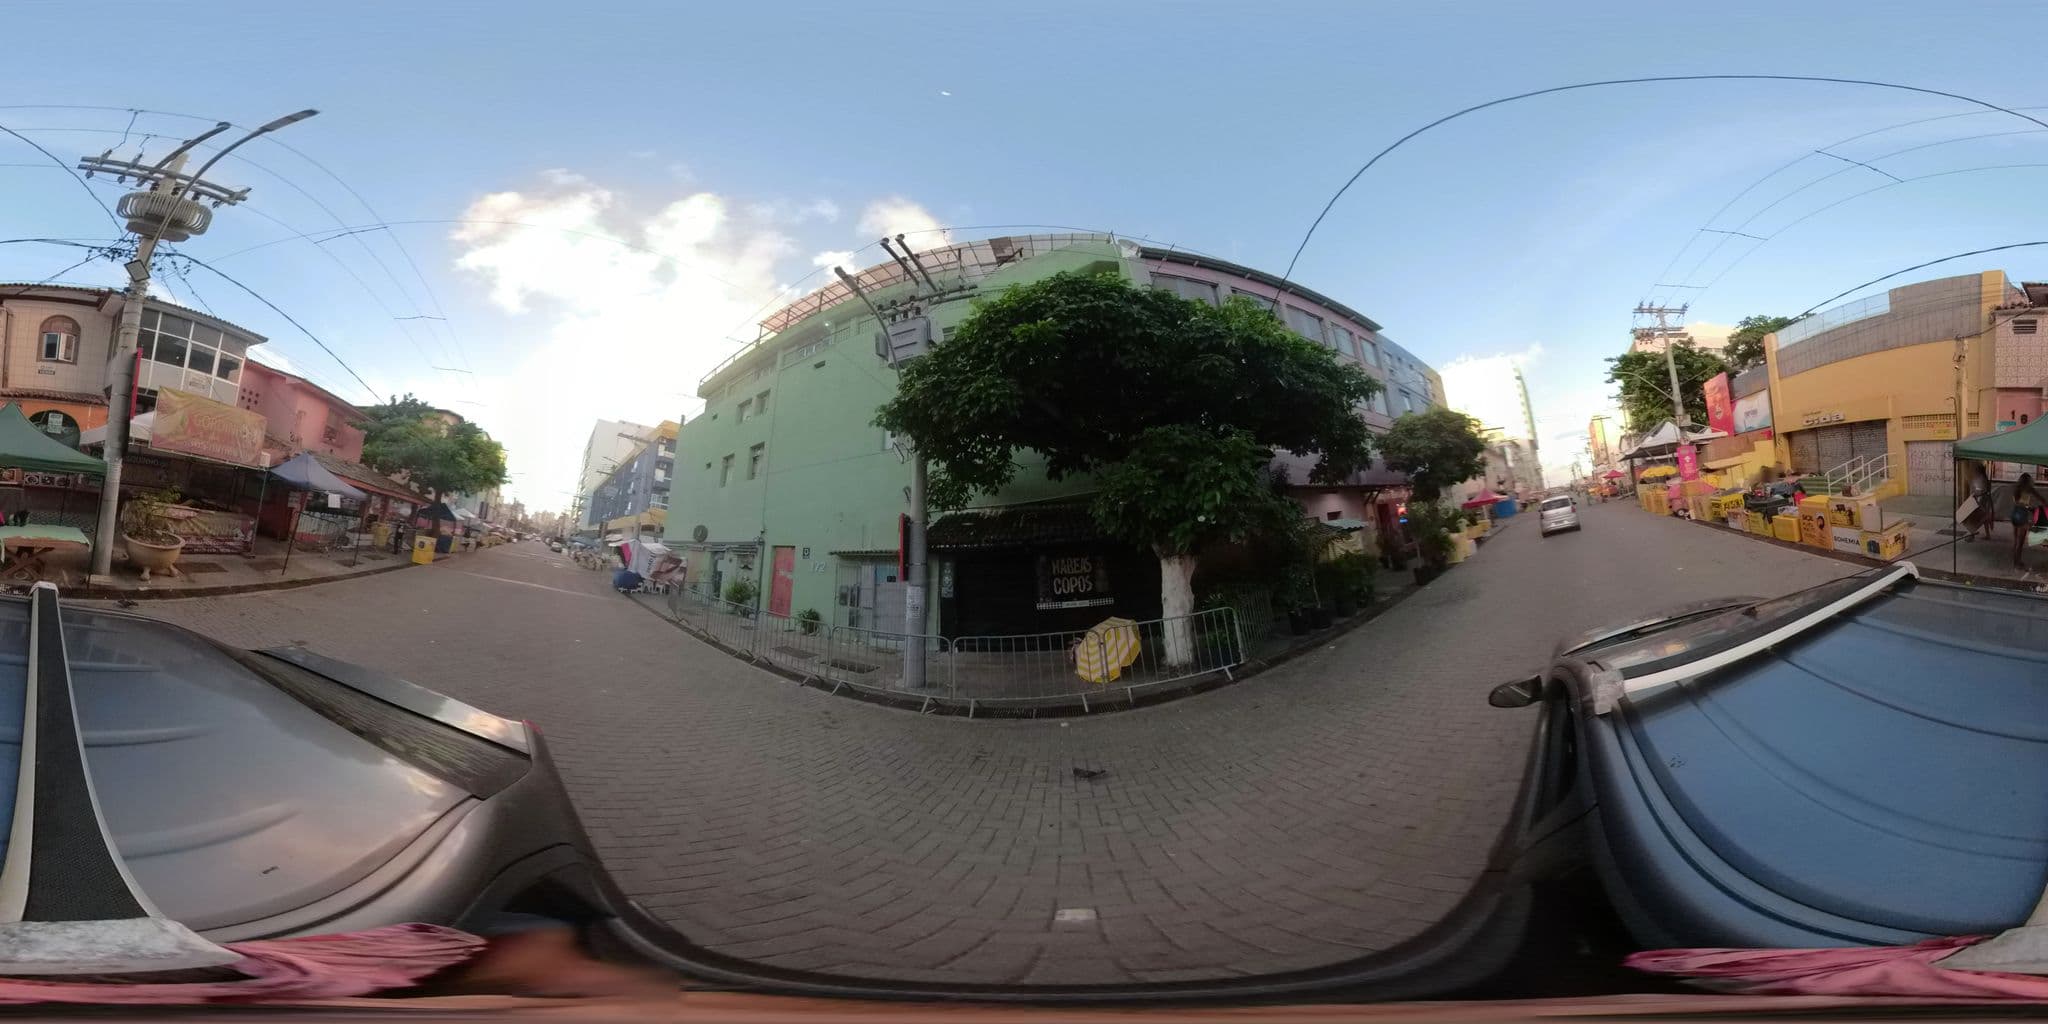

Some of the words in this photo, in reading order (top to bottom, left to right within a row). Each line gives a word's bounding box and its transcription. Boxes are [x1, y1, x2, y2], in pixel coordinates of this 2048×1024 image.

[1833, 535, 1861, 546] BOHEMIA
[1051, 558, 1092, 575] HABEAS
[1053, 575, 1093, 594] COPOS
